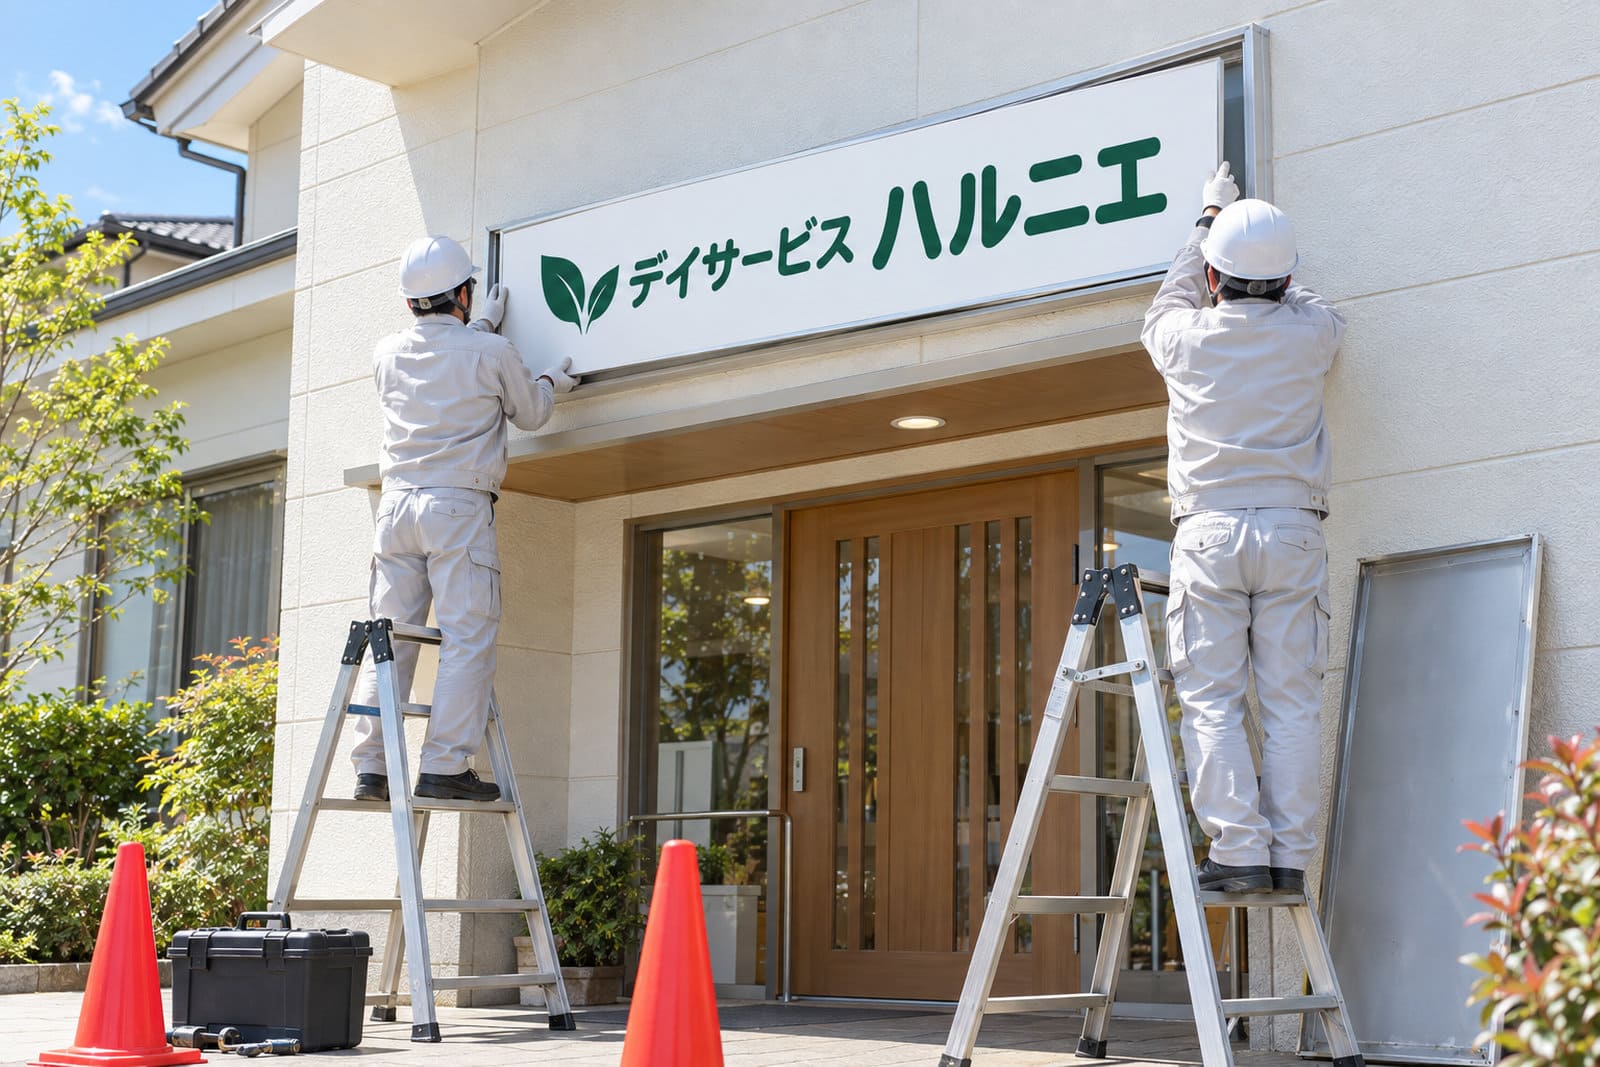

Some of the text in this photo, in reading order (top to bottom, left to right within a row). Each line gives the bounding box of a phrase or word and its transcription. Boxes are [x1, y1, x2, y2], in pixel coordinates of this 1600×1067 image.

[629, 136, 1168, 308] デイサービス ハルニエ
